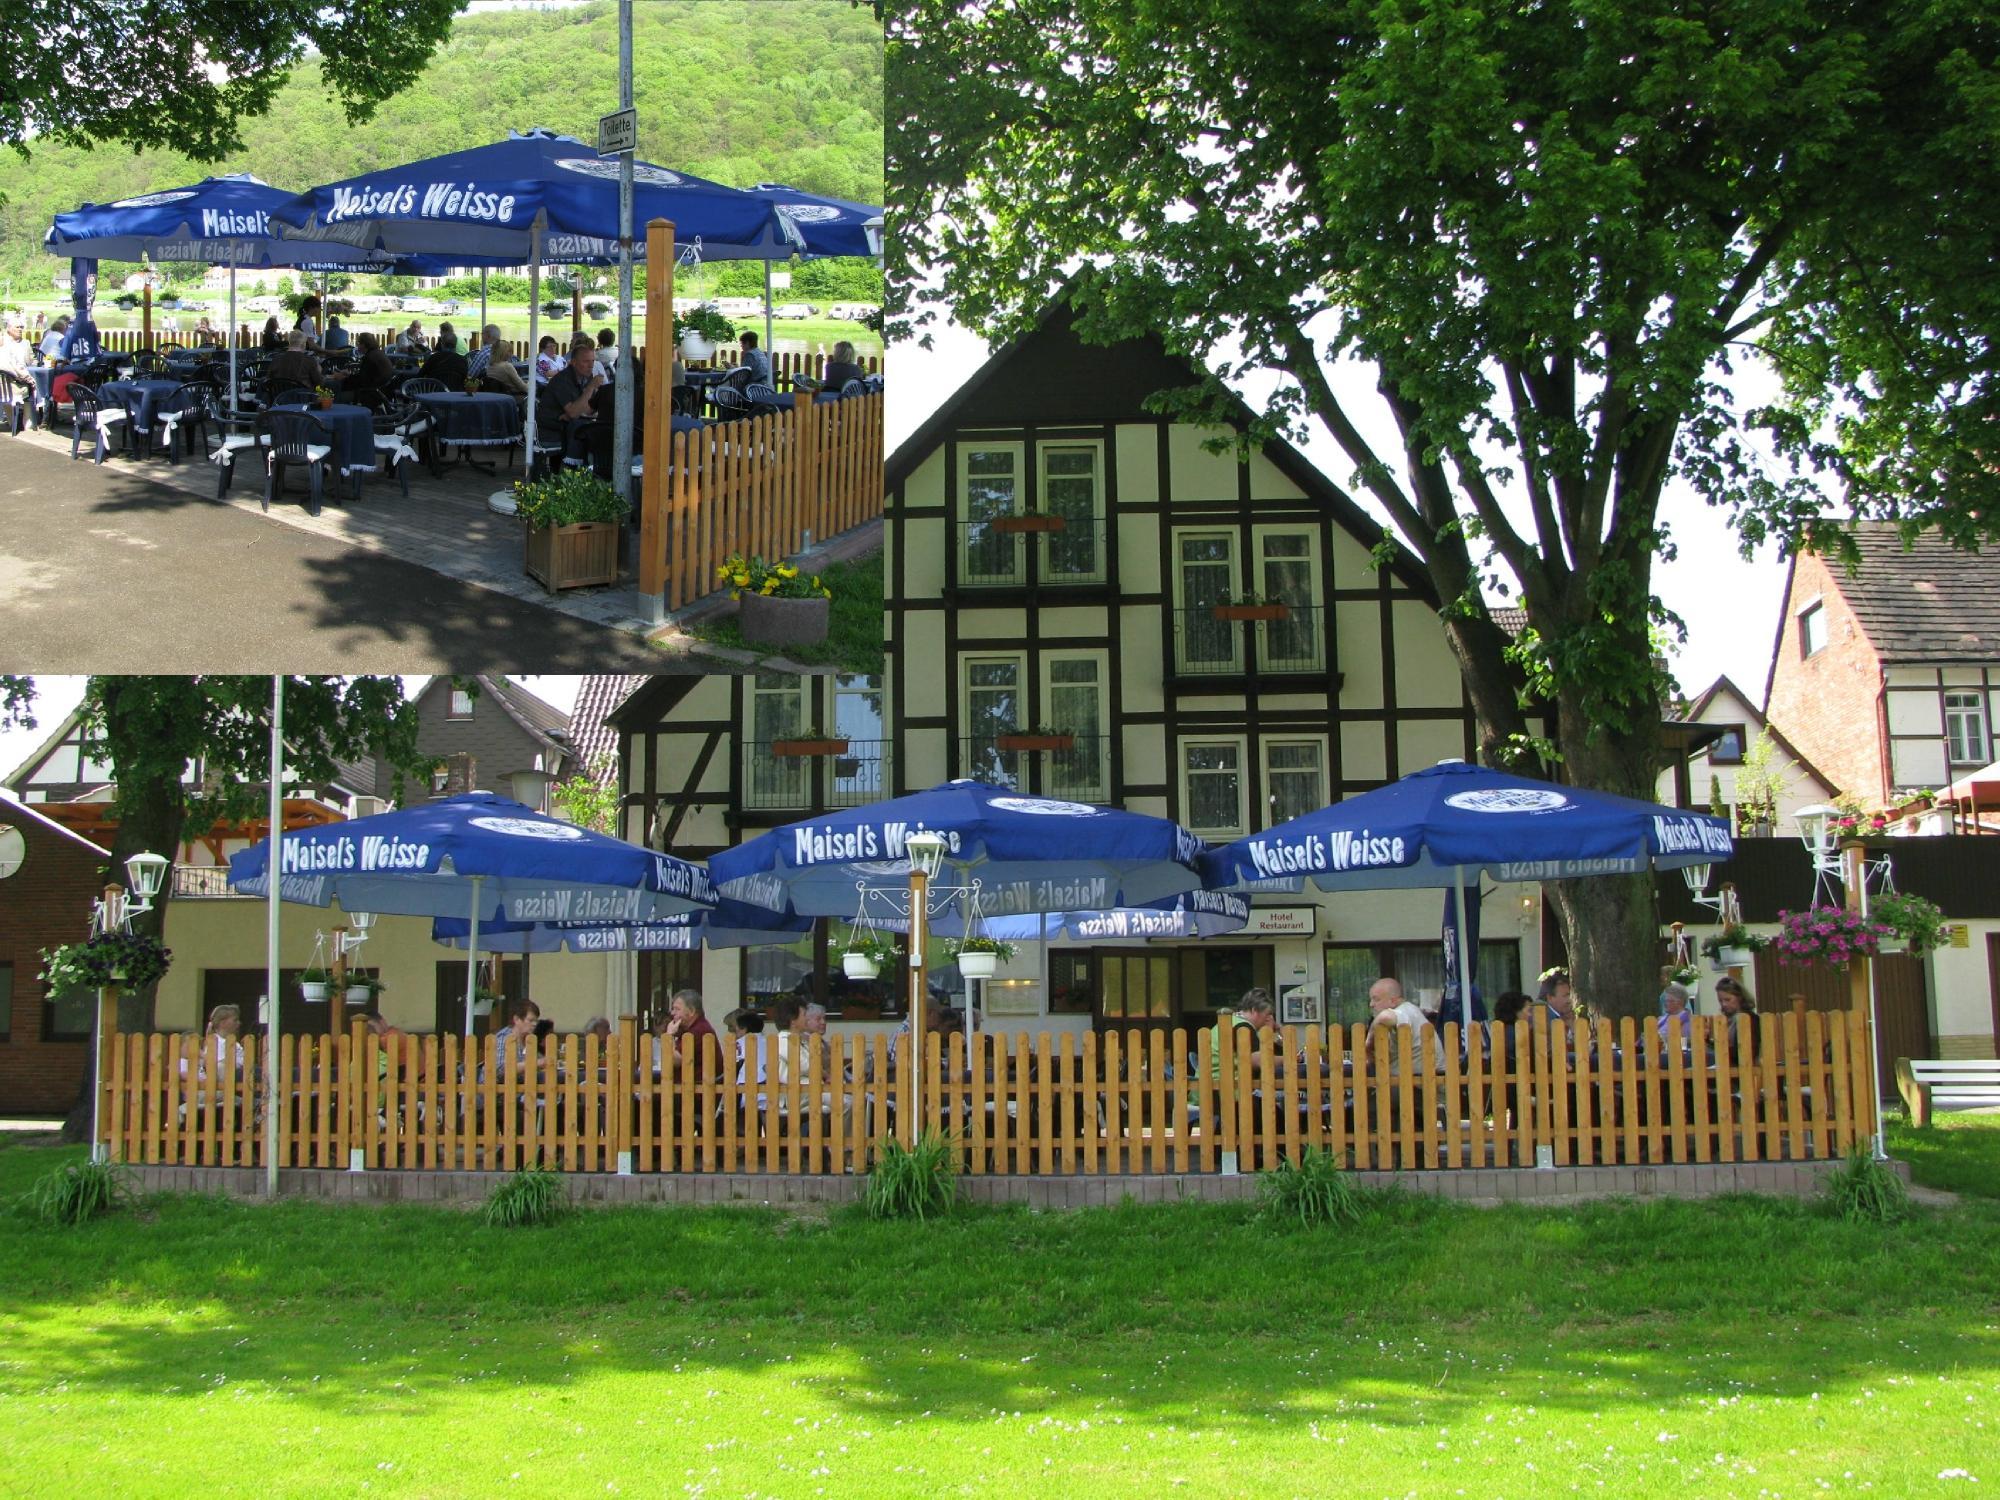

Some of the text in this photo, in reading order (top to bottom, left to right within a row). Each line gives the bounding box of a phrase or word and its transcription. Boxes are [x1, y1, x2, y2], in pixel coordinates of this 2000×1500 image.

[603, 117, 632, 136] Toilette
[327, 182, 516, 223] Maisel's Weisse
[795, 824, 878, 865] Maisel's
[1653, 815, 1701, 853] Maisel's
[281, 836, 430, 874] Maisel's Weisse
[1249, 835, 1327, 878] Maisel's
[1331, 829, 1405, 870] Weisse
[655, 855, 690, 895] Maisel's
[1260, 921, 1304, 930] Restaurant
[1270, 912, 1293, 921] Hotel
